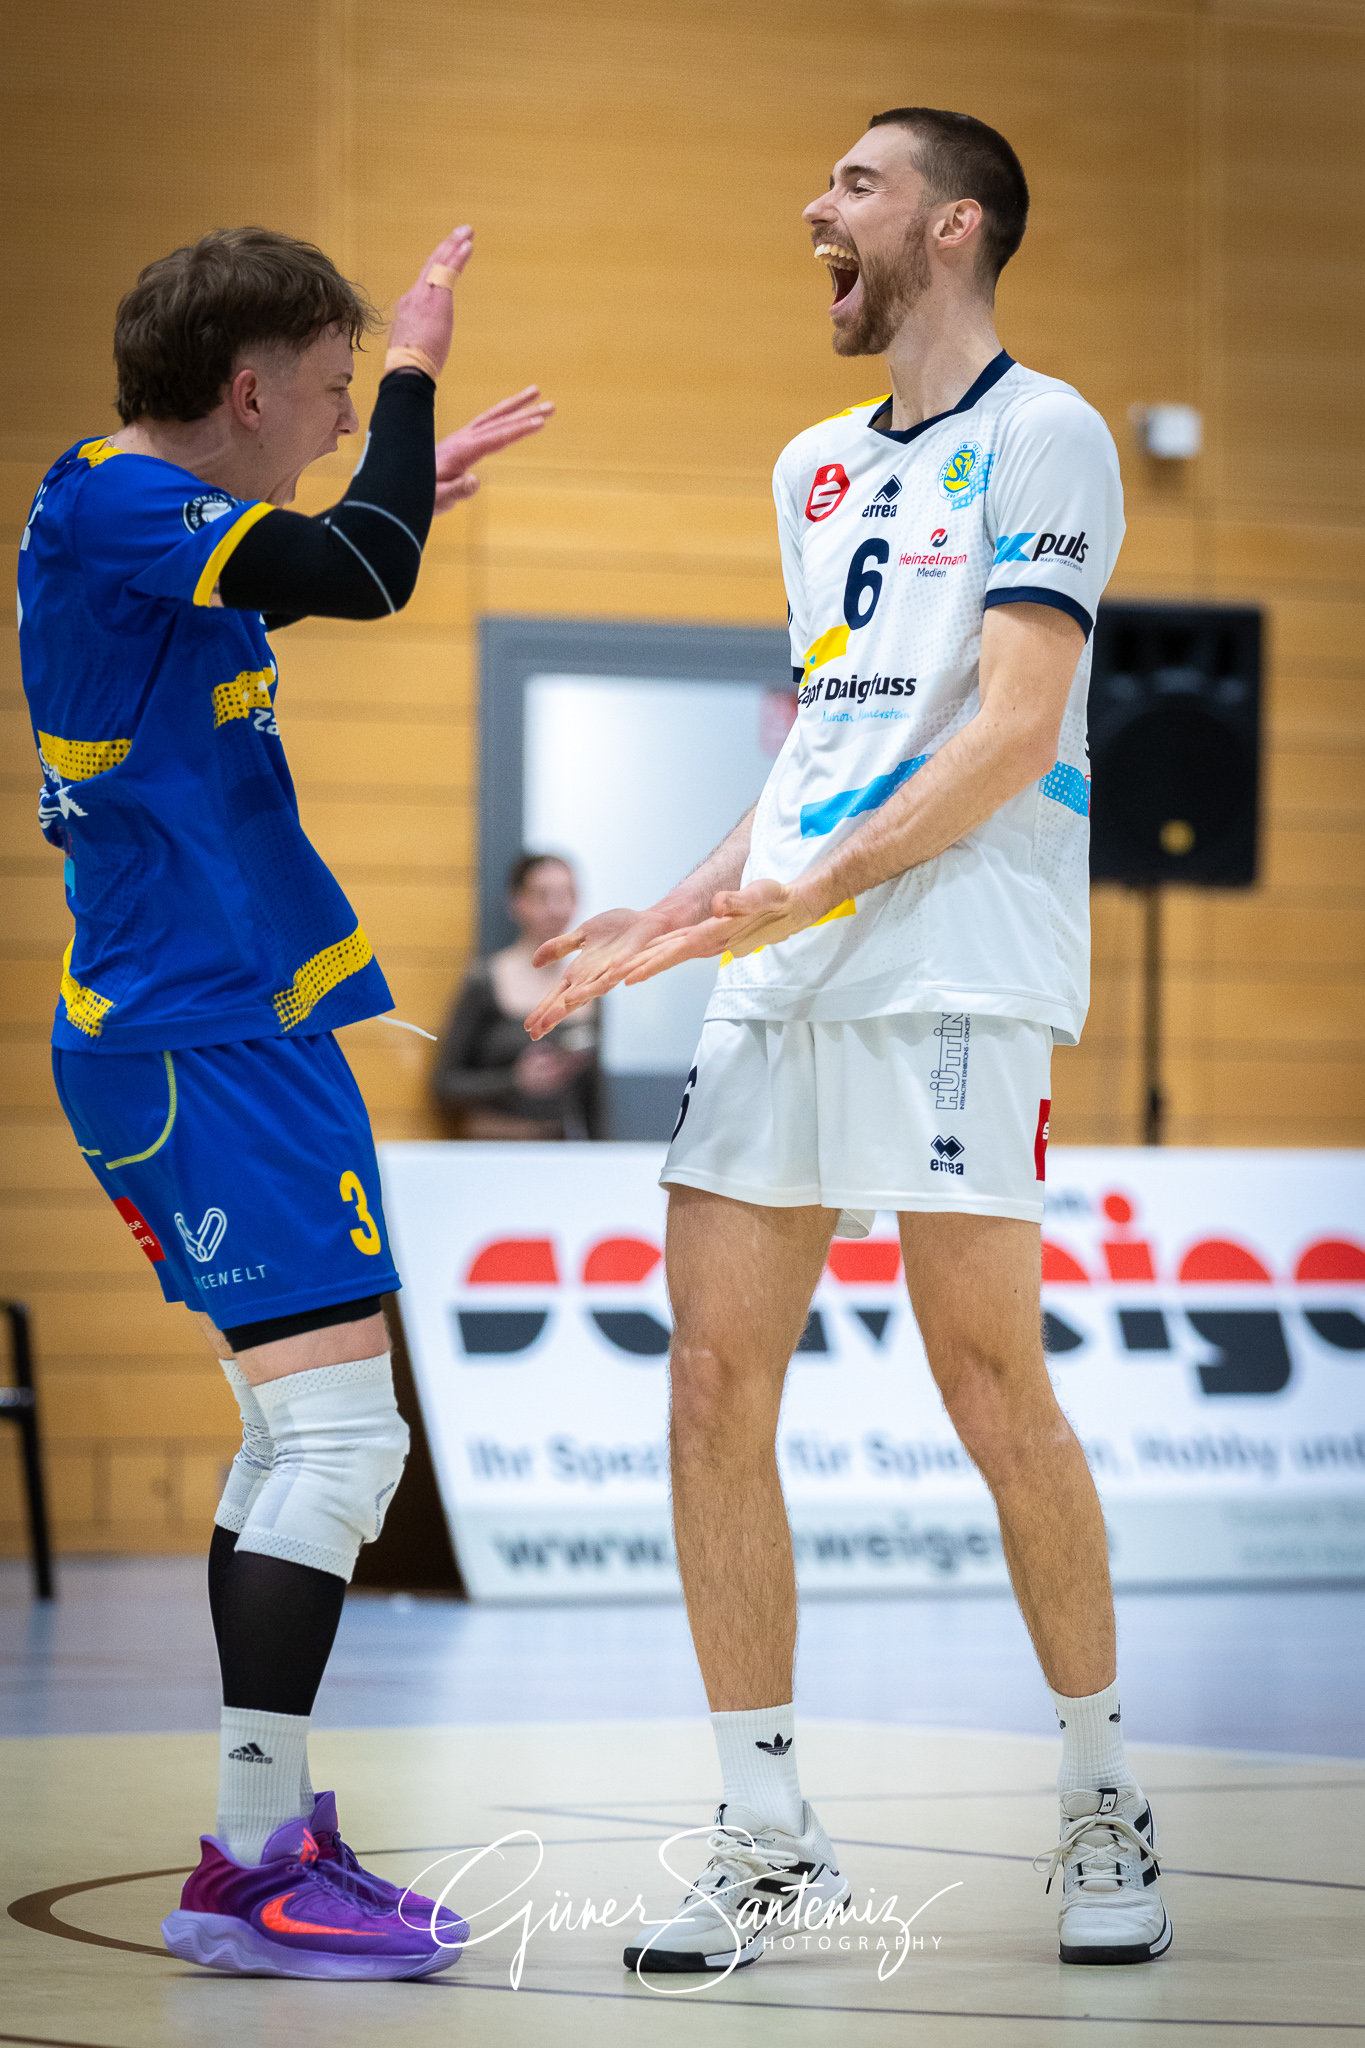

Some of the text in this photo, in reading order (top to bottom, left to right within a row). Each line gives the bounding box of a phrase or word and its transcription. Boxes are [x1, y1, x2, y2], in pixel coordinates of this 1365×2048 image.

[899, 552, 967, 566] Heinzelmann
[1031, 531, 1089, 564] puls
[843, 537, 890, 631] 6
[917, 567, 947, 578] Medien
[825, 672, 918, 704] Daigfuss
[961, 1046, 969, 1078] EXHIBITIONS
[340, 1170, 382, 1256] 3
[228, 1752, 273, 1765] adidas
